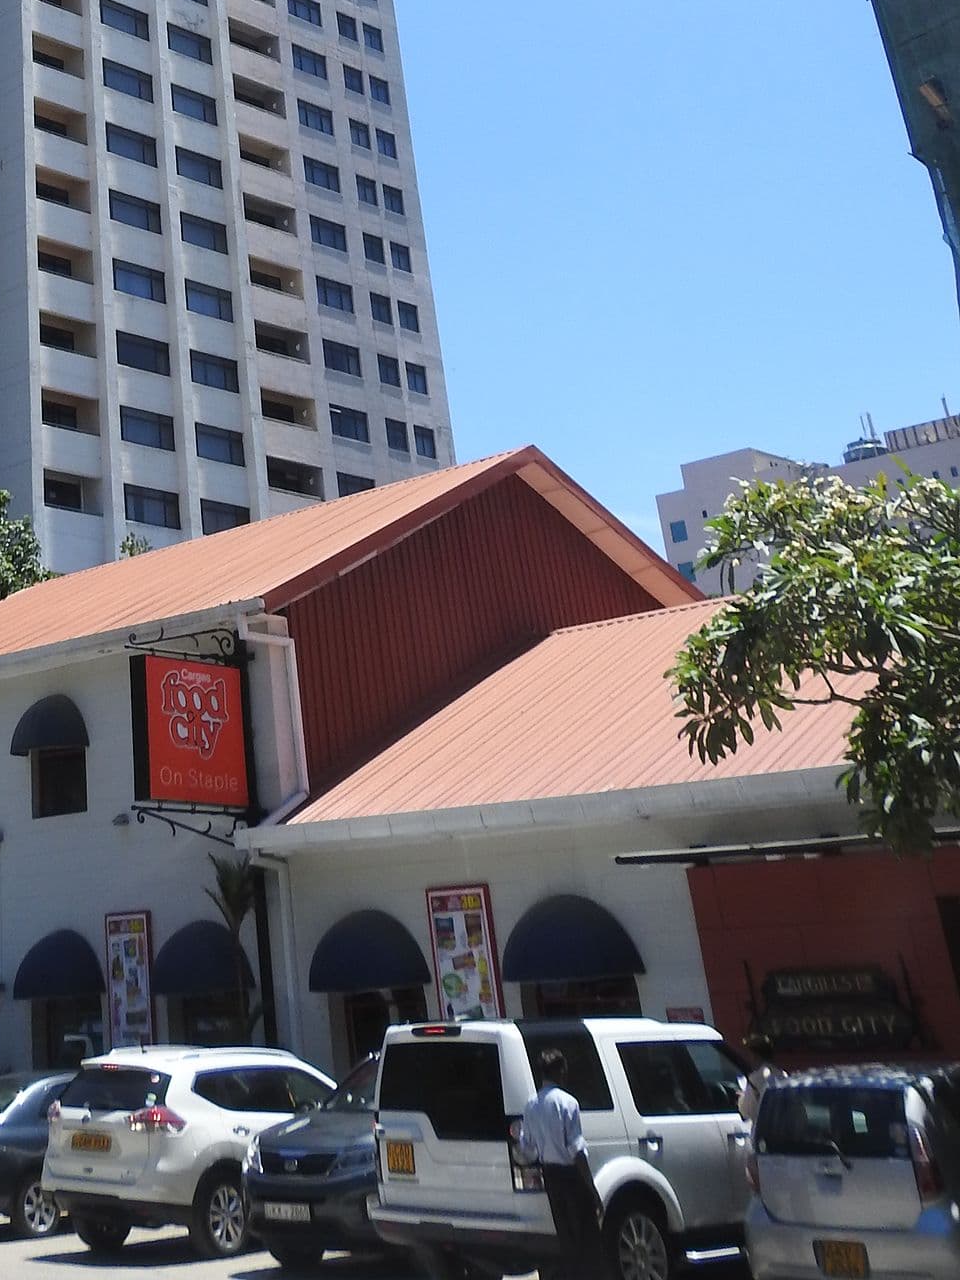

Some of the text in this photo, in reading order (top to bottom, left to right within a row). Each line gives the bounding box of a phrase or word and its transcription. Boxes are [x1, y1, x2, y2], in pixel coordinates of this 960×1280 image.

[163, 671, 228, 721] food
[171, 711, 222, 759] city
[160, 766, 238, 793] On Staple
[841, 1013, 896, 1035] CITY
